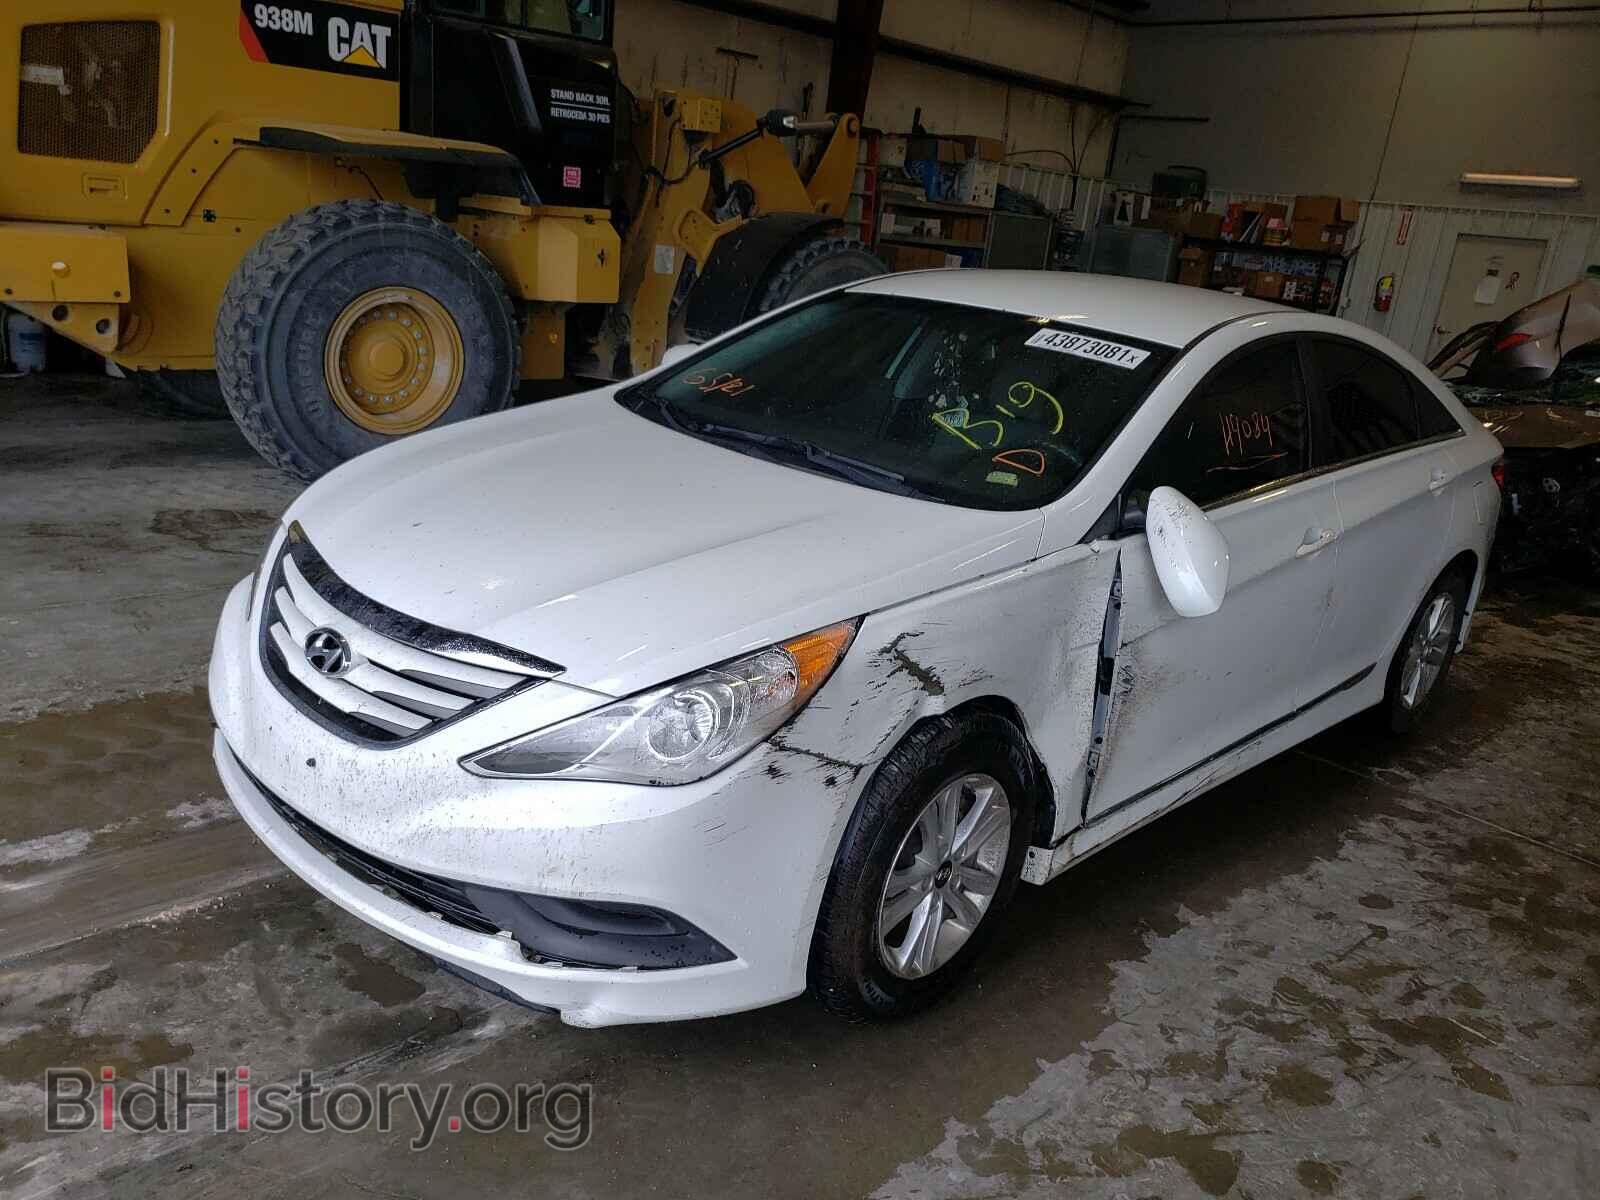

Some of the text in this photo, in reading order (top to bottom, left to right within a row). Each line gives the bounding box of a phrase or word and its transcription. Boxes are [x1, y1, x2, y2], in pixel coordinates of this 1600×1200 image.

[254, 3, 314, 36] 938M
[327, 16, 392, 70] CAT
[550, 88, 575, 101] STAND
[576, 92, 595, 104] BACK
[1043, 333, 1131, 362] 43873081
